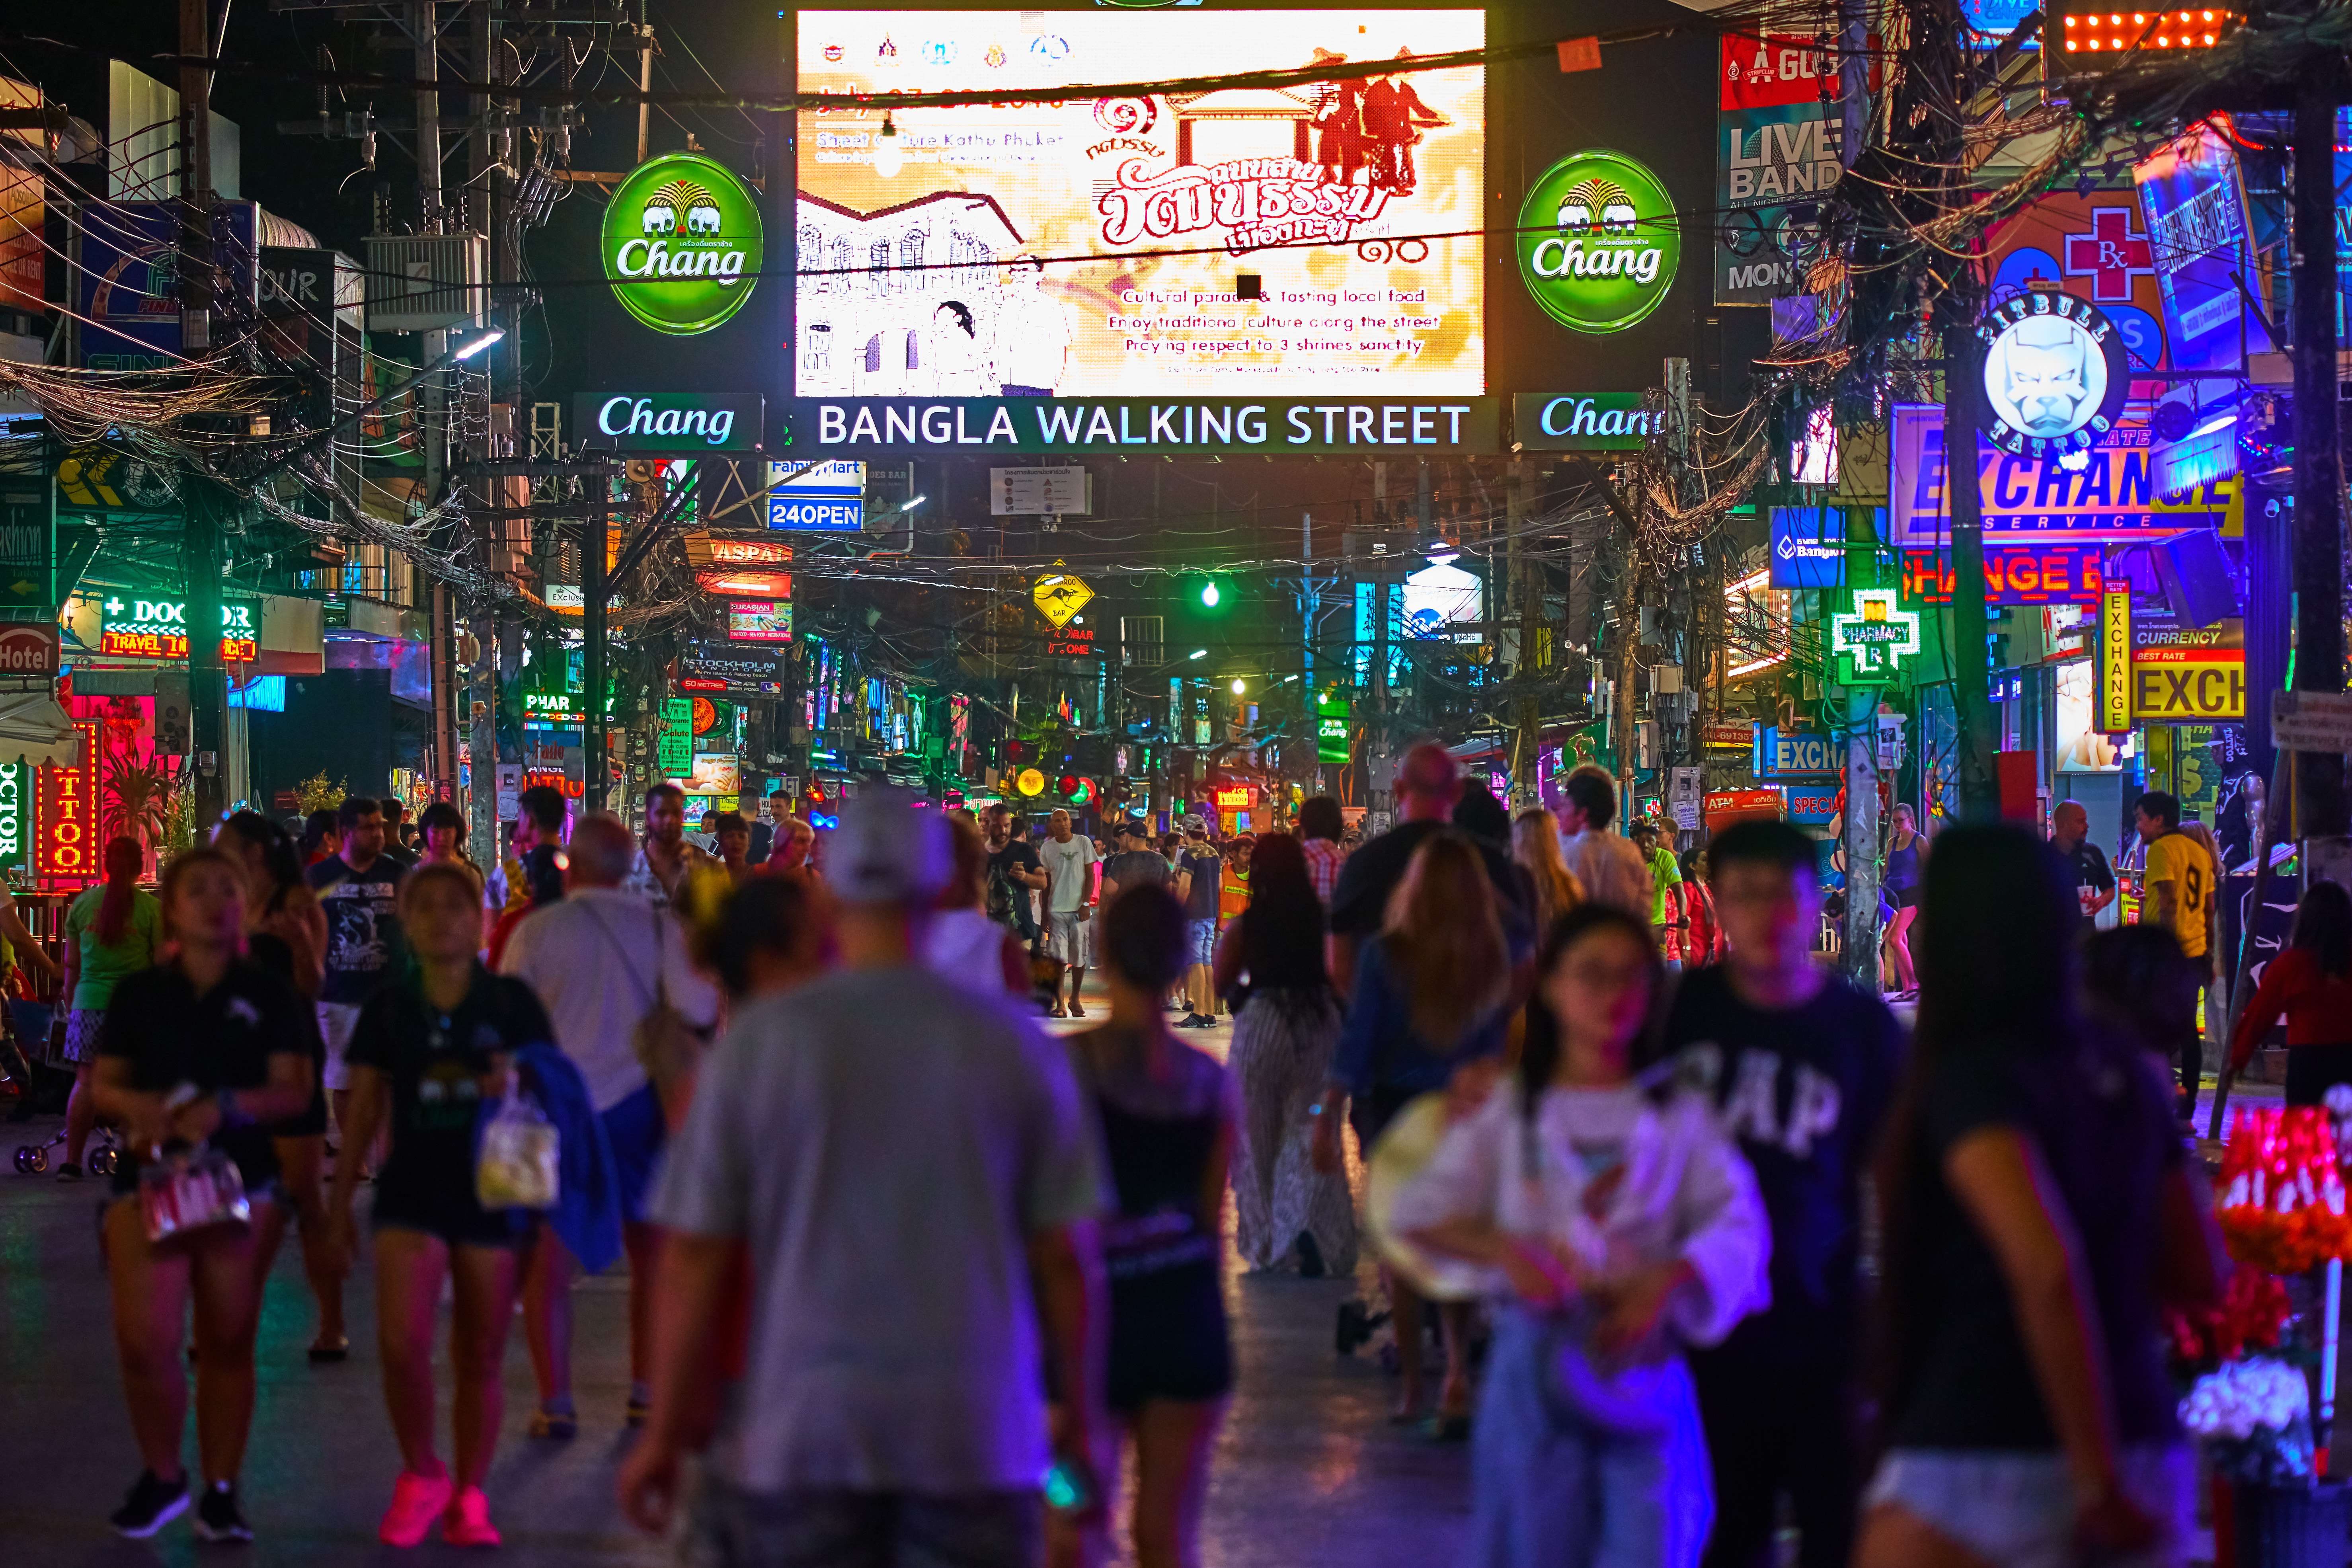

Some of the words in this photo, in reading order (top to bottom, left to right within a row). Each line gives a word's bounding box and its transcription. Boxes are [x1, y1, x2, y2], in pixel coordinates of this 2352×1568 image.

[1731, 119, 1842, 168] LIVE
[1730, 160, 1842, 199] BAND
[616, 239, 747, 288] Chang
[1532, 238, 1663, 284] Chang
[1123, 290, 1187, 302] Cultural
[1280, 290, 1336, 306] Tasting
[1344, 290, 1381, 302] local
[1389, 290, 1424, 302] food
[1110, 317, 1152, 332] Enjoy
[1159, 316, 1240, 328] traditional
[1248, 316, 1303, 328] culture
[1309, 316, 1353, 332] along
[1361, 317, 1386, 327] the
[1394, 317, 1438, 328] street
[1126, 339, 1185, 354] Praying
[1193, 339, 1249, 354] respect
[1258, 340, 1272, 350] to
[1281, 339, 1288, 350] 3
[1297, 339, 1352, 351] shrines
[1360, 339, 1421, 355] sanctity
[598, 396, 735, 445] Chang
[819, 405, 1018, 443] BANGLA
[1036, 405, 1267, 443] WALKING
[1287, 405, 1471, 443] STREET
[1990, 415, 2110, 458] TATTOO
[2098, 429, 2152, 446] ATE
[1984, 515, 2151, 529] SERVICE
[1073, 630, 1094, 640] BAR
[1843, 626, 1909, 642] PHARMACY
[2136, 632, 2221, 644] CURRENCY
[112, 636, 161, 651] TRAVEL
[0, 646, 50, 669] Hotel
[685, 659, 776, 670] STOCKHOLM
[2111, 595, 2123, 726] EXCHANGE
[1318, 727, 1347, 739] Chang
[1708, 797, 1734, 809] ATM
[54, 774, 81, 866] TTOO
[2188, 864, 2207, 912] 9
